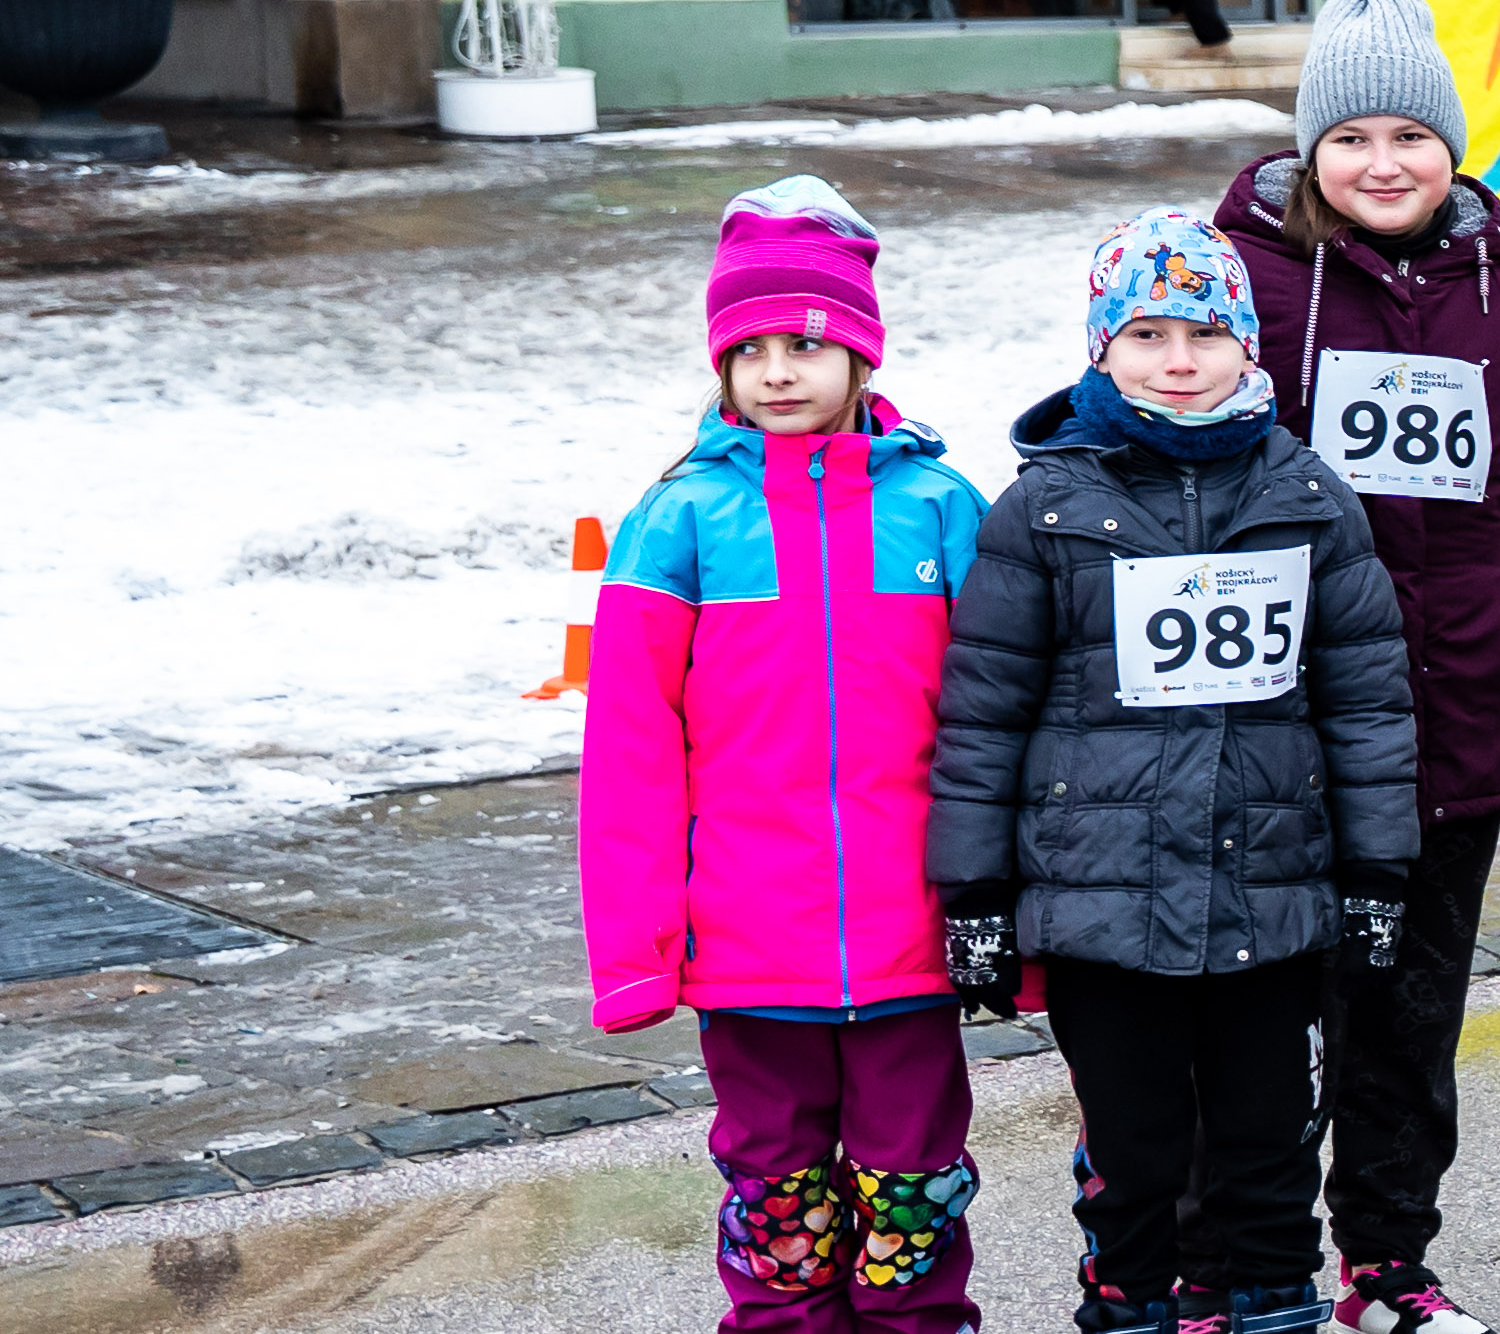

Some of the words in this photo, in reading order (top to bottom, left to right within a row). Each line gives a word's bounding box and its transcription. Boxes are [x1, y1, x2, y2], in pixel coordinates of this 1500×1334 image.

[1411, 370, 1447, 381] KOŠICKÝ
[1341, 400, 1476, 469] 986
[1215, 568, 1255, 578] KOŠICKÝ
[1145, 599, 1293, 674] 985
